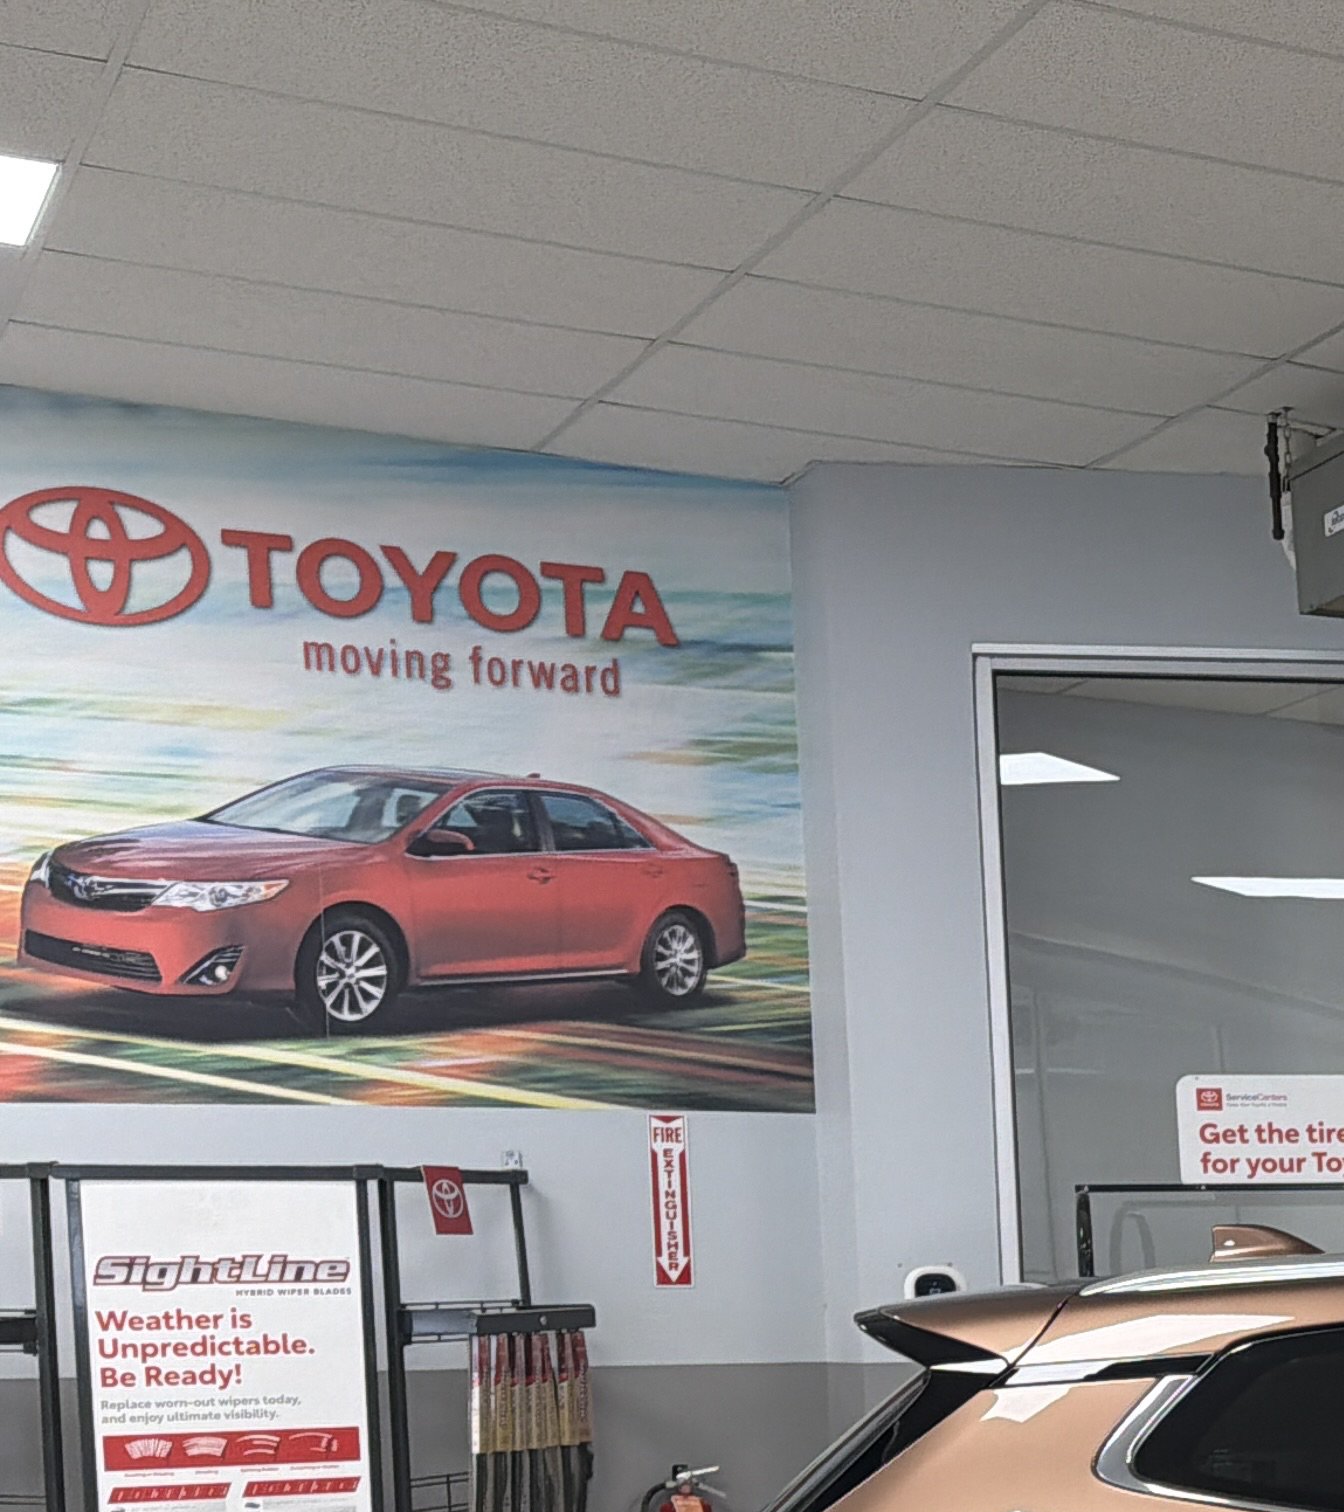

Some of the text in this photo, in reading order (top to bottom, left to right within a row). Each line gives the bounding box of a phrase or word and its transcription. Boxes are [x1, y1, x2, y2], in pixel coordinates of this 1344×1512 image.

[221, 529, 680, 646] TOYOTA
[302, 638, 621, 698] moving forward
[653, 1127, 683, 1143] FIRE
[1199, 1123, 1249, 1144] Get
[1255, 1121, 1300, 1144] the
[1200, 1152, 1240, 1173] for
[1246, 1155, 1307, 1178] your
[662, 1149, 679, 1271] EXTINGUISHER
[93, 1254, 350, 1292] SightLine
[235, 1287, 352, 1297] HYBRID WIPER BLADES
[95, 1307, 253, 1332] Weather is
[98, 1333, 315, 1363] Unpredictable.
[100, 1364, 242, 1391] Be Ready!
[101, 1400, 152, 1412] Replace
[155, 1397, 215, 1408] worn-out
[218, 1396, 260, 1408] wipers
[101, 1408, 280, 1425] and enjoy ultimate visibility.
